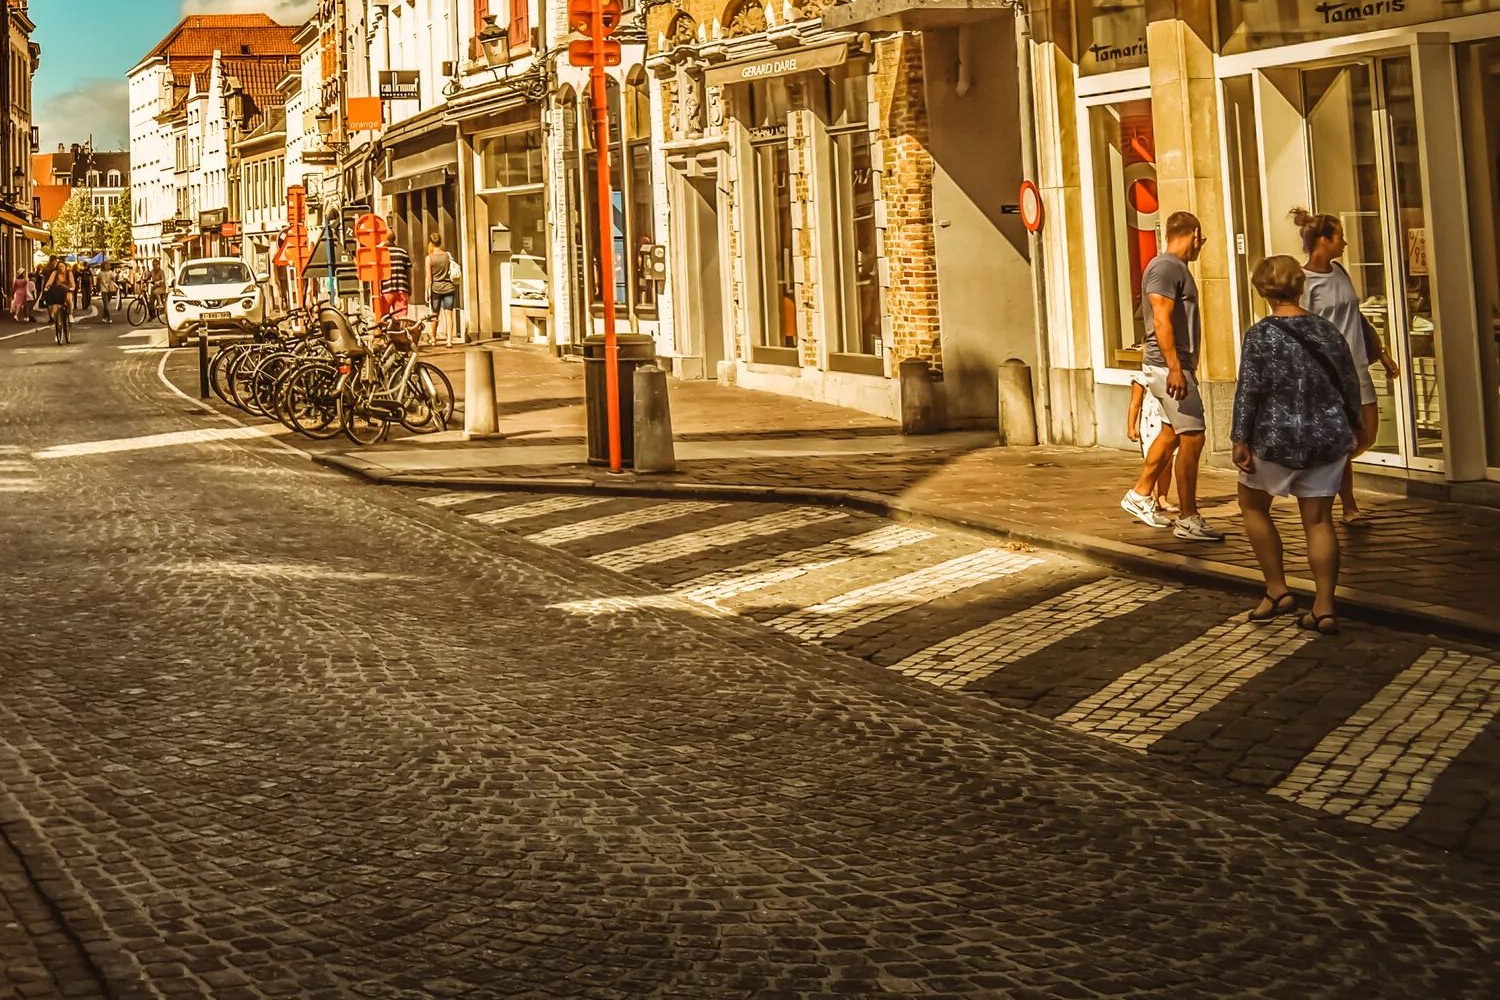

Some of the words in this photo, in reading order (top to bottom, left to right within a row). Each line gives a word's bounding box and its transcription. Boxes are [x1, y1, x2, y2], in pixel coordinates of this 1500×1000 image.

[741, 62, 773, 78] GERARD
[773, 58, 797, 73] DAREL
[350, 121, 380, 129] orange
